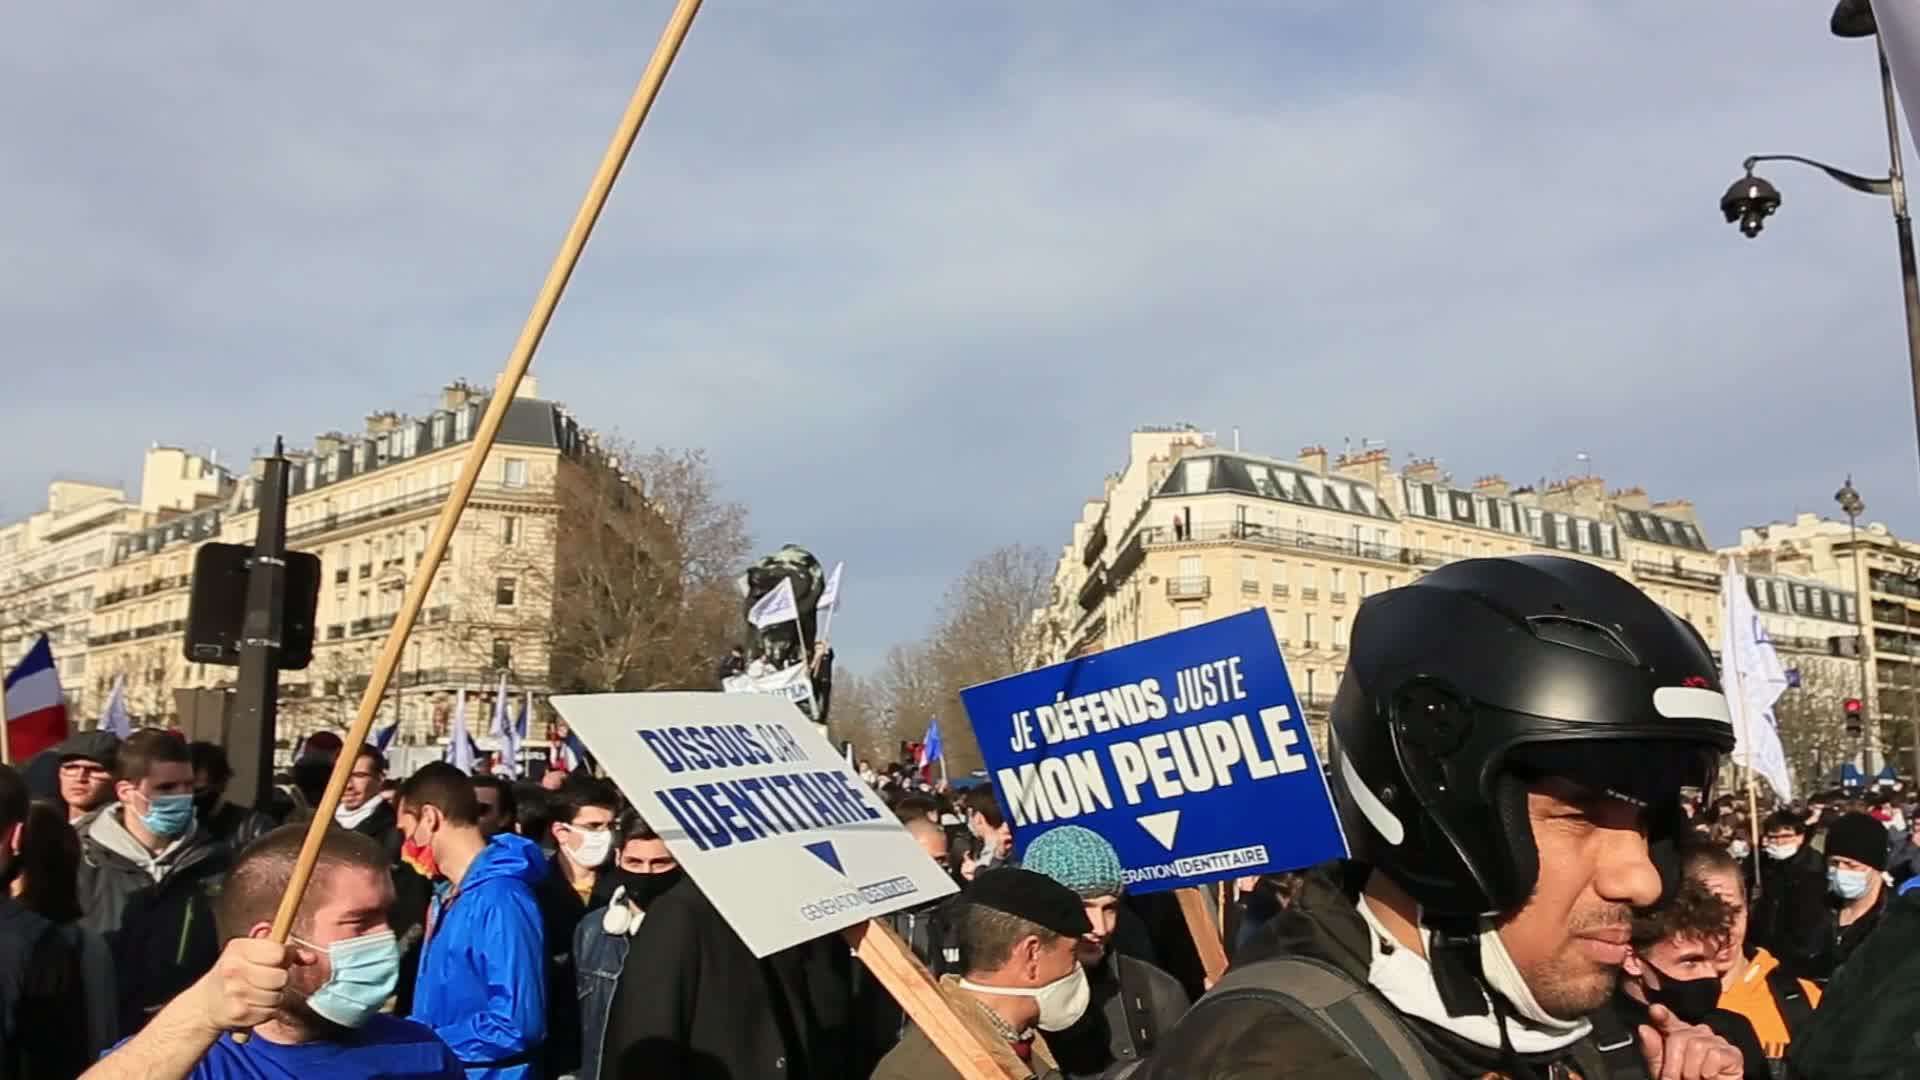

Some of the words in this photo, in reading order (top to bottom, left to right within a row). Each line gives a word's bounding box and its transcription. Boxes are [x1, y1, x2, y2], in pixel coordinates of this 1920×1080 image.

[1010, 711, 1037, 752] JE
[1035, 678, 1169, 745] DÉFENDS
[1173, 656, 1247, 714] JUSTE
[638, 723, 774, 773] DISSOUS
[755, 723, 809, 763] CAR
[997, 750, 1114, 827] MON
[1109, 704, 1307, 805] PEUPLE
[654, 770, 882, 851] IDENTITAIRE
[1120, 863, 1177, 885] ÉRATION
[1178, 848, 1266, 875] IDENTITAIRE
